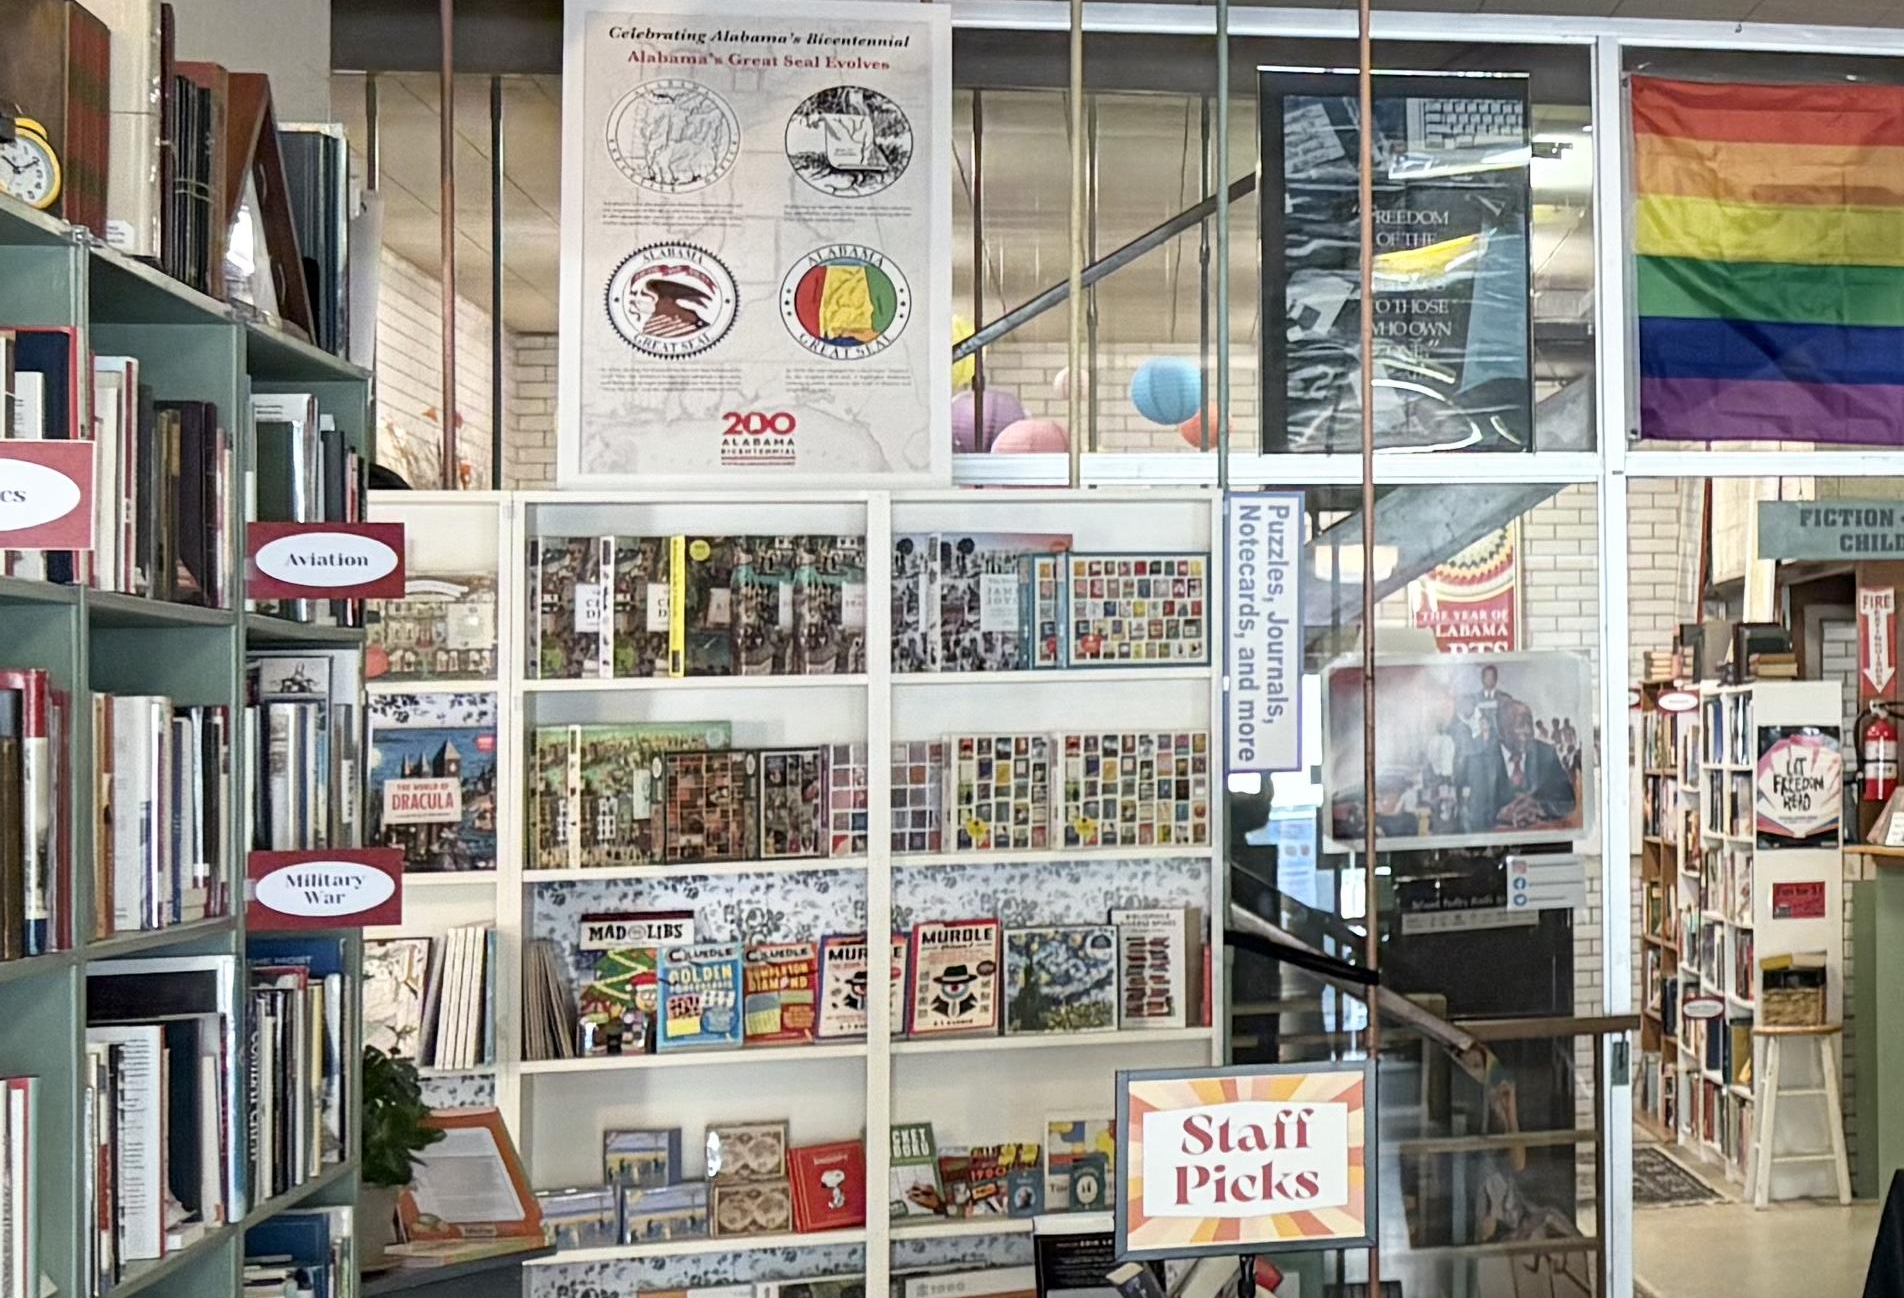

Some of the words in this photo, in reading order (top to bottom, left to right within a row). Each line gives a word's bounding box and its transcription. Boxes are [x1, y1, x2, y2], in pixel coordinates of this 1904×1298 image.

[608, 26, 707, 44] Celebrating
[710, 29, 801, 47] Alabama's
[806, 33, 910, 49] Bicentennial
[628, 51, 723, 68] Alabama's
[728, 53, 779, 68] Great
[783, 54, 820, 69] Seal
[824, 56, 891, 71] Evolves
[1376, 233, 1399, 247] OF
[1394, 298, 1449, 314] THOSE
[1408, 320, 1452, 336] OWN
[722, 411, 796, 435] 200
[722, 438, 795, 447] ALABAMA
[1799, 507, 1894, 528] FICTION
[284, 550, 370, 569] Aviation
[1266, 505, 1291, 603] Puzzles,
[1236, 505, 1261, 638] Notecards,
[1861, 594, 1892, 610] FIRE
[1449, 609, 1490, 623] YEAR
[1492, 608, 1509, 622] OF
[1239, 647, 1260, 691] and
[1262, 612, 1291, 725] Journals,
[1237, 701, 1256, 762] more
[391, 792, 455, 811] DRACULA
[285, 872, 366, 890] Military
[304, 890, 347, 905] War
[588, 924, 626, 941] MAD
[647, 922, 684, 940] LIBS
[921, 926, 992, 944] MURDLE
[1179, 1107, 1315, 1156] Staff
[1173, 1157, 1320, 1207] Picks
